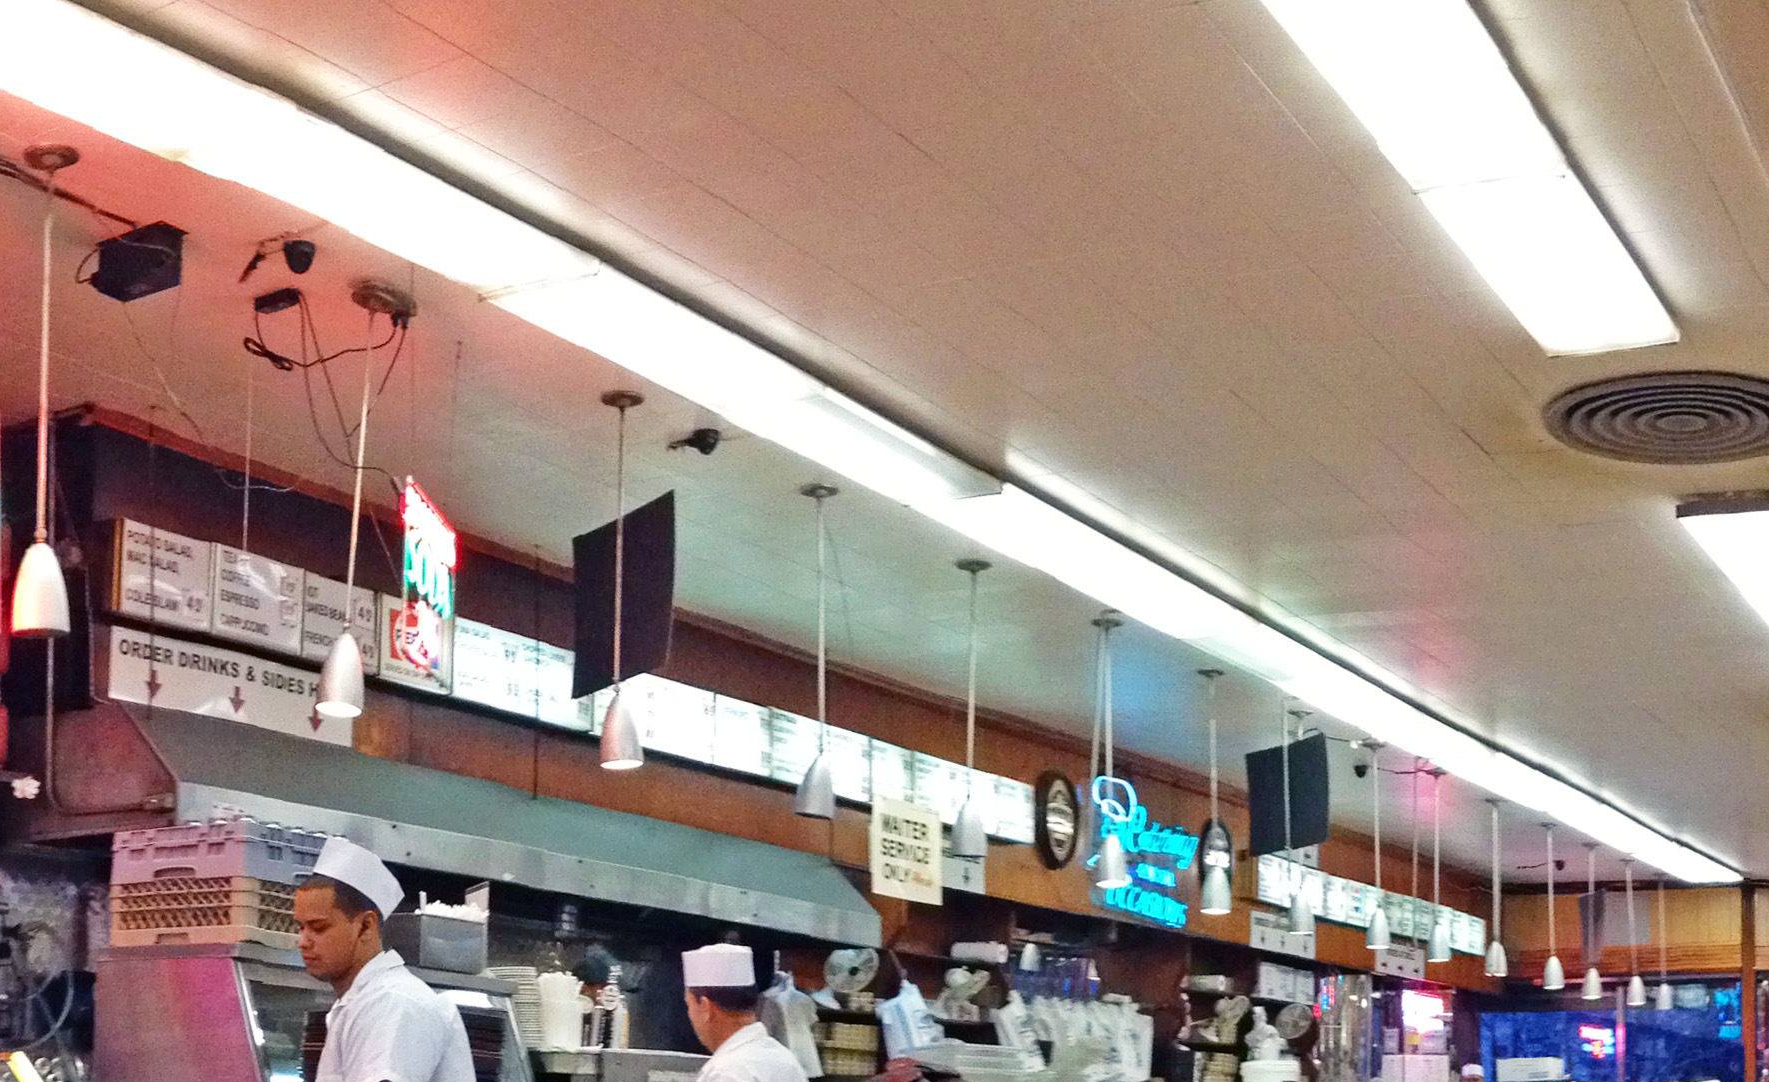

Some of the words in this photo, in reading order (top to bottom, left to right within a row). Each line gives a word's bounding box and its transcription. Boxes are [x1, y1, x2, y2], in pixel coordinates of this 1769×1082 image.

[119, 638, 173, 666] ORDER
[178, 653, 240, 679] DRINKS
[246, 665, 255, 681] &
[262, 670, 305, 696] SIDES
[879, 812, 930, 842] WAITER
[881, 837, 931, 865] SERVICE
[882, 862, 911, 884] ONLY
